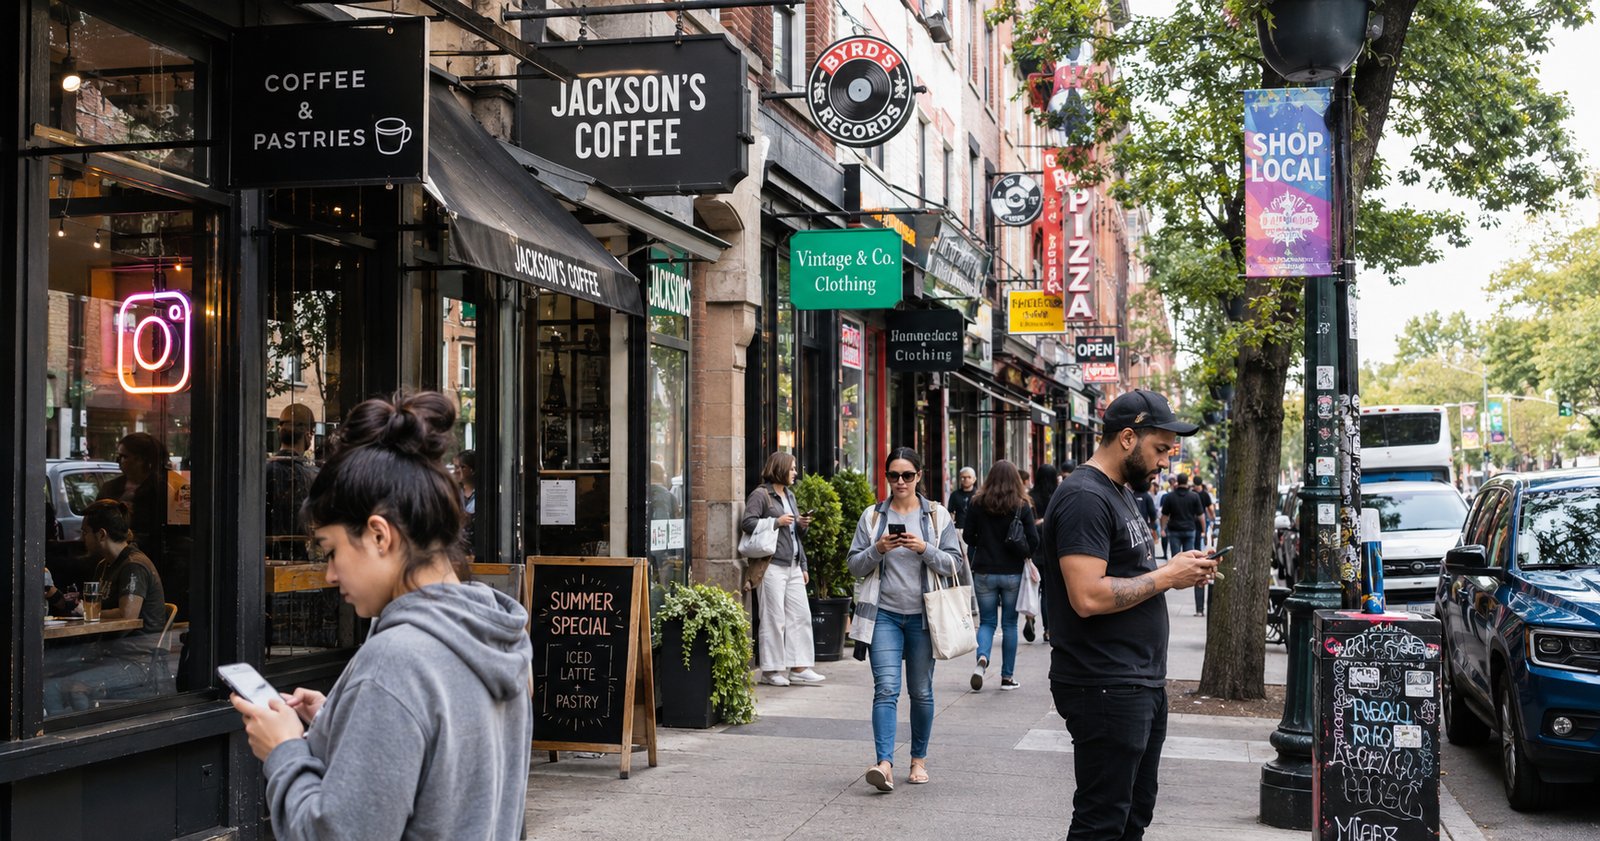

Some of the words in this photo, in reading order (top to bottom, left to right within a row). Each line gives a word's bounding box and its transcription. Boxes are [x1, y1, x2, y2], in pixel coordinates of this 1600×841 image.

[823, 42, 897, 72] BYRD'S
[264, 69, 366, 92] COFFEE
[551, 73, 707, 118] JACKSON'S
[297, 101, 314, 120] &
[818, 104, 901, 139] RECORDS
[253, 128, 366, 151] PASTRIES
[574, 118, 681, 159] COFFEE
[1252, 131, 1324, 156] SHOP
[1251, 157, 1326, 183] LOCAL
[796, 250, 852, 271] Vintage
[856, 250, 867, 266] &
[872, 247, 895, 266] Co.
[1067, 188, 1094, 319] PIZZA
[514, 244, 567, 287] JACKSON'S
[567, 263, 601, 297] COFFEE
[649, 264, 692, 317] JACKSON'S
[815, 275, 876, 296] Clothing
[895, 348, 952, 363] Clothing
[1077, 343, 1113, 357] OPEN
[550, 591, 614, 611] SUMMER
[551, 616, 611, 636] SPECIAL
[565, 651, 592, 664] ICED
[560, 667, 596, 682] LATTE
[556, 694, 599, 709] PASTRY
